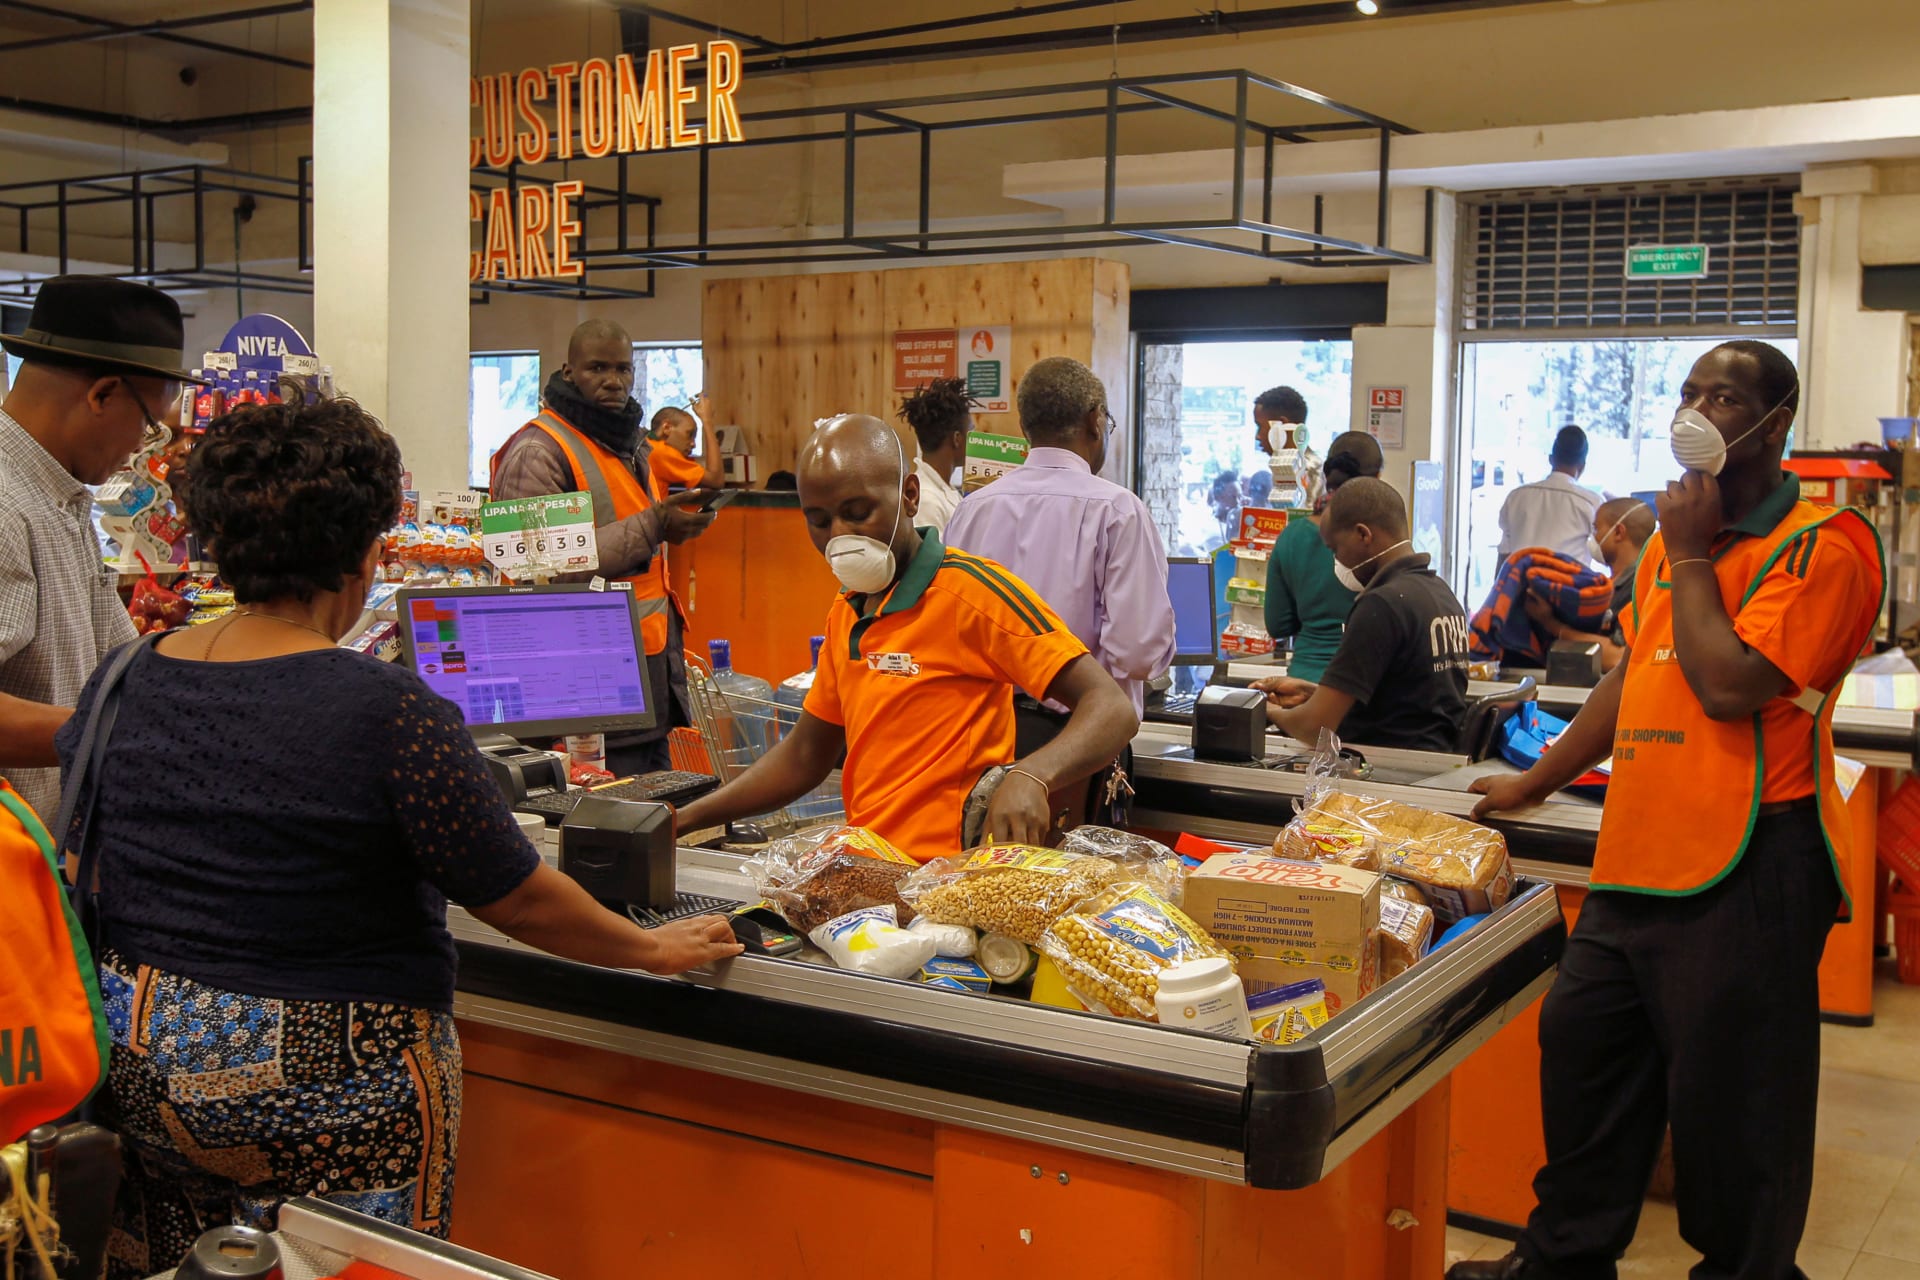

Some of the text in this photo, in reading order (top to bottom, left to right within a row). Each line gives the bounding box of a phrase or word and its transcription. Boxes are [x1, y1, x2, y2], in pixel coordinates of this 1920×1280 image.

[1632, 252, 1699, 262] EMERGENCY
[1653, 262, 1678, 271] EXIT
[237, 336, 289, 357] NIVEA
[896, 340, 954, 350] FOOD STUFFS ONCE
[903, 354, 946, 364] SOLD ARE NOT
[905, 369, 945, 378] RETURNABLE
[968, 437, 983, 445] LIPA
[971, 466, 977, 475] 5
[984, 469, 991, 477] 6
[484, 507, 508, 517] LIPA
[509, 504, 525, 514] NA
[495, 535, 586, 556] 5 6 6 3 9
[1632, 729, 1684, 744] SHOPPING
[1220, 865, 1342, 889] Yello
[1296, 906, 1310, 914] BEST
[1213, 911, 1231, 920] HIGH
[1244, 915, 1278, 924] STACKING
[1279, 918, 1313, 927] MAXIMUM
[1213, 921, 1313, 937] AWAY FROM DIRECT SUNLIGHT
[1210, 931, 1229, 941] PLAC
[1230, 933, 1244, 941] DRY
[1286, 938, 1294, 946] IN
[1296, 939, 1317, 948] STORE
